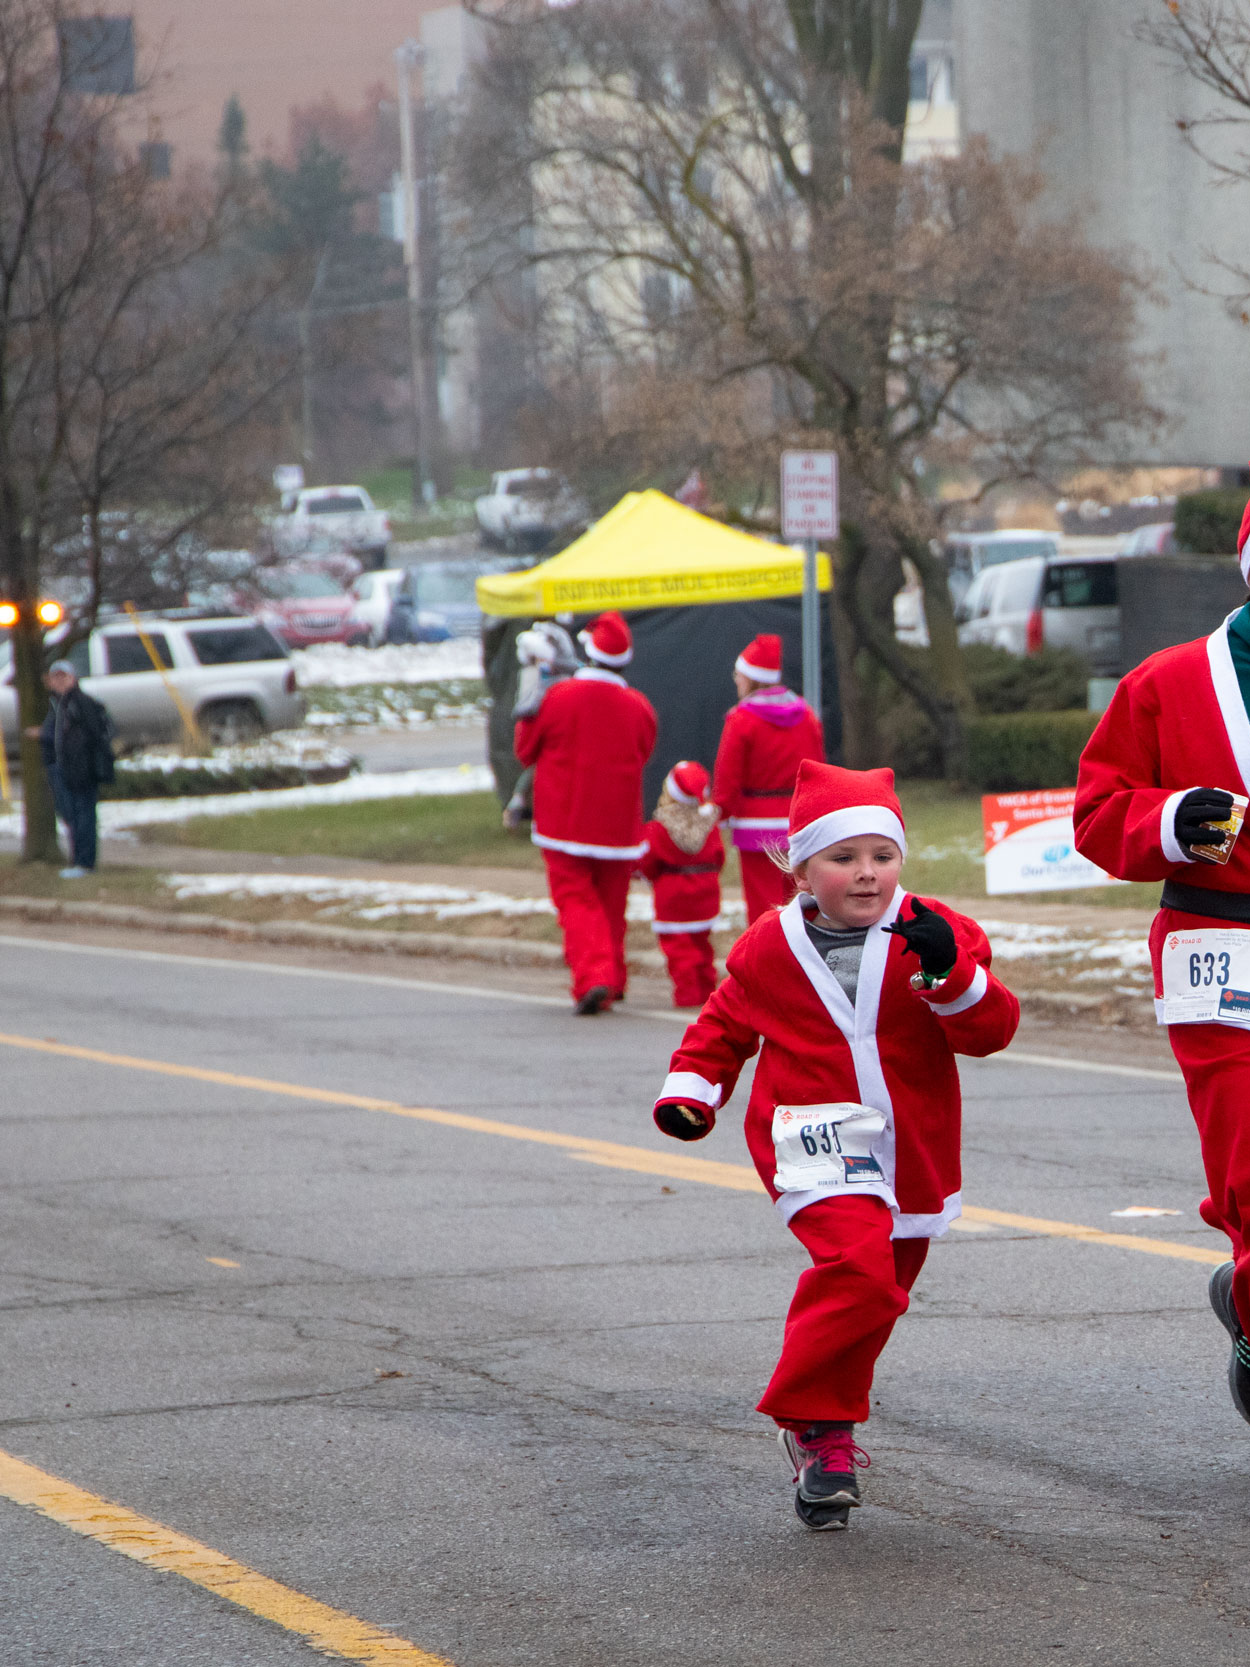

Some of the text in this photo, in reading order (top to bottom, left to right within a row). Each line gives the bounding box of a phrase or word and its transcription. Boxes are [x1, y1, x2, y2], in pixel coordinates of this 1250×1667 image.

[785, 474, 831, 486] STOPPING
[786, 489, 831, 500] STANDING
[786, 518, 830, 530] PARKING
[554, 568, 802, 601] INFINITE MULTISPOR
[997, 791, 1077, 807] YMCA of Greate
[1013, 808, 1044, 821] Santa
[1189, 952, 1231, 988] 633
